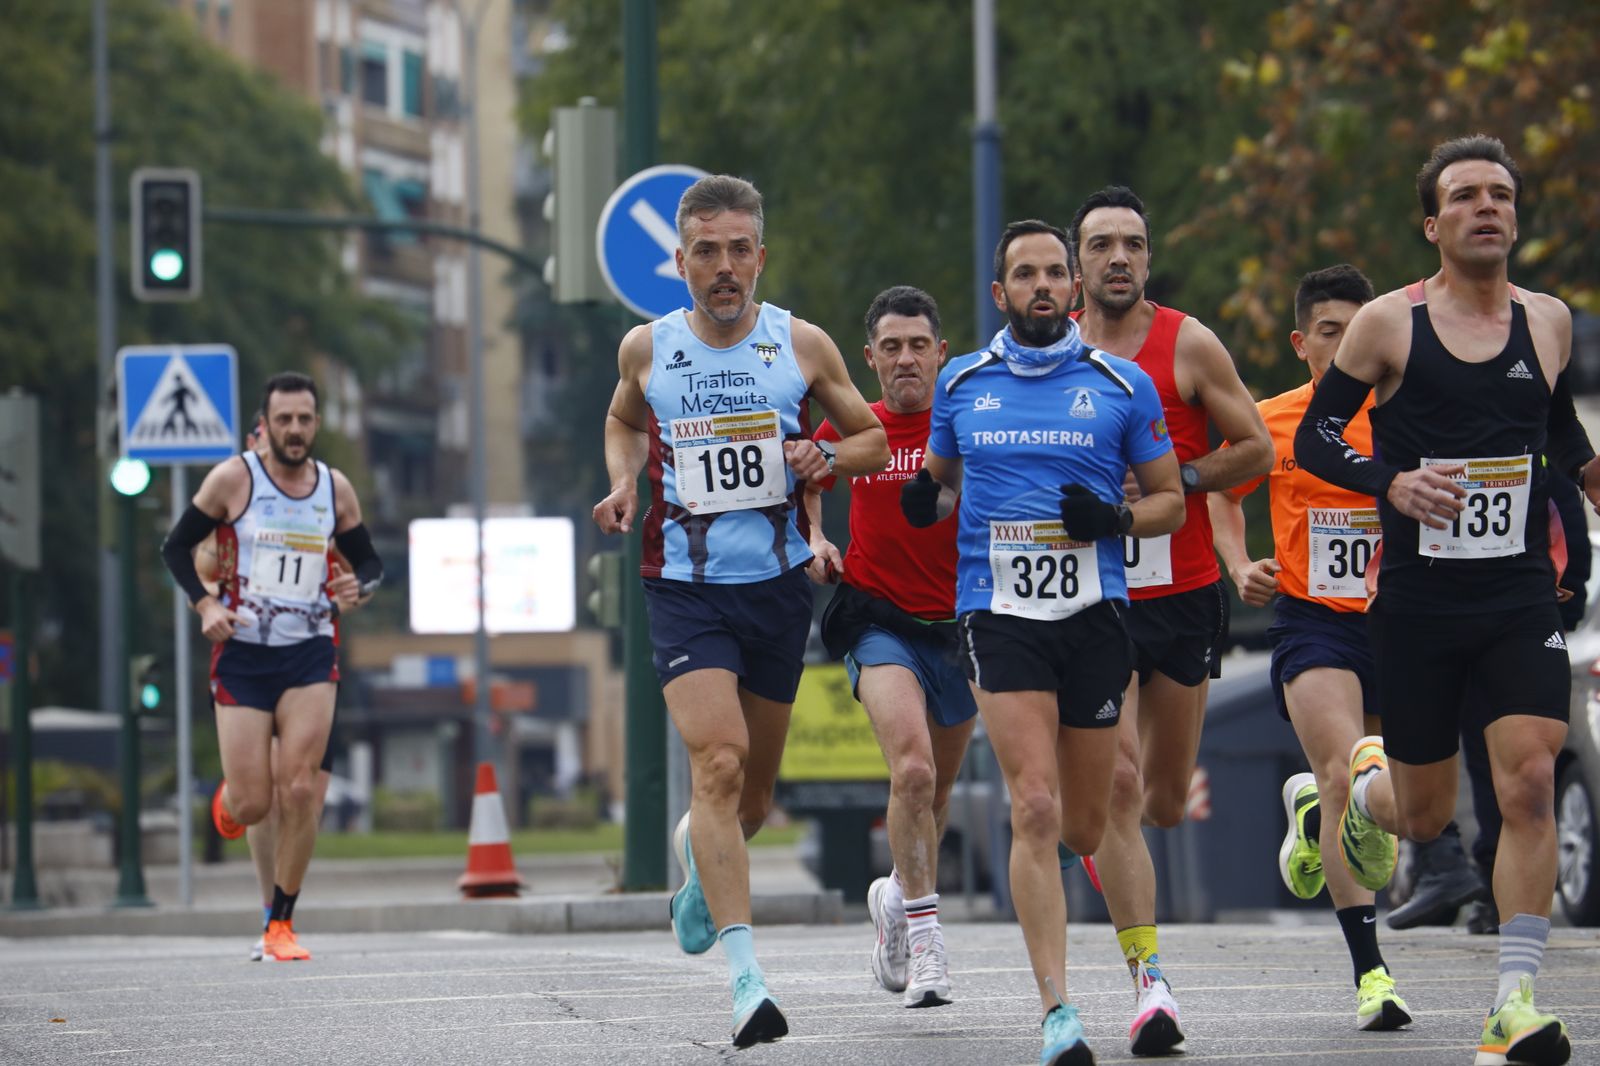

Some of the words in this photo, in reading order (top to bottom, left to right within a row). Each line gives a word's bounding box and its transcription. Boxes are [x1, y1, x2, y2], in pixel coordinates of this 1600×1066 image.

[666, 360, 692, 370] VIATOR
[1506, 371, 1533, 380] adidas
[674, 420, 714, 438] XXXIX
[732, 431, 777, 442] TRINITARIOS
[972, 430, 1094, 448] TROTASIERRA
[698, 445, 764, 492] 198
[1485, 478, 1527, 488] TRINITARIOS
[1312, 511, 1350, 526] XXXIX
[1452, 492, 1512, 538] 133
[994, 525, 1033, 541] XXXIX
[1328, 538, 1382, 578] 30
[278, 554, 302, 584] 11
[1012, 554, 1080, 599] 328
[1544, 641, 1567, 651] adidas
[1095, 710, 1118, 720] adidas
